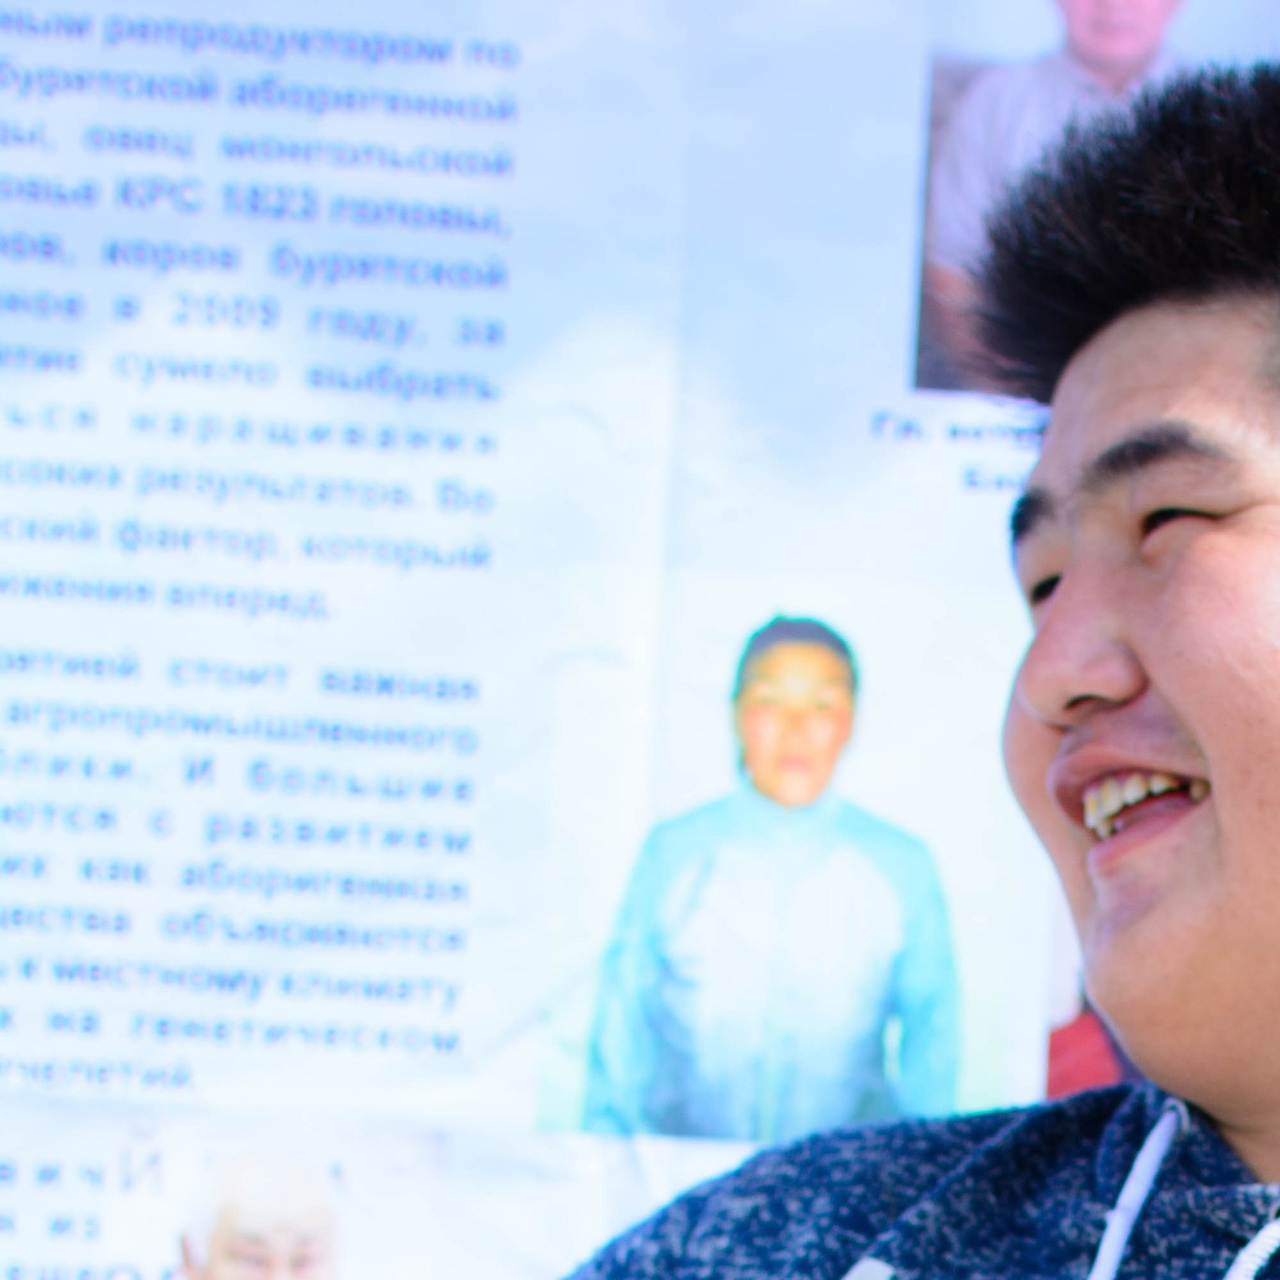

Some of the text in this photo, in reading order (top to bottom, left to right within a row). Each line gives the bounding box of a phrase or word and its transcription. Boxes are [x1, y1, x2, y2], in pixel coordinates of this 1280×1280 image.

[103, 16, 452, 63] репродуктором
[465, 39, 520, 67] по
[81, 124, 192, 157] овец
[219, 135, 514, 175] монгольской
[114, 175, 203, 213] КРС
[100, 236, 239, 272] коров
[270, 242, 507, 287] бурятской
[113, 294, 138, 319] в
[174, 291, 278, 328] 2009
[455, 316, 504, 346] за
[113, 354, 276, 385] сумело
[305, 362, 498, 400] выбрать
[131, 413, 496, 451] наращивания
[302, 537, 492, 569] который
[166, 659, 288, 686] стоит
[318, 668, 478, 702] важная
[7, 701, 478, 752] агропромышленного
[182, 754, 214, 785] И
[246, 758, 474, 801] большие
[148, 809, 168, 834] с
[204, 815, 471, 853] развитием
[78, 857, 149, 883] как
[178, 858, 467, 901] аборигенная
[160, 907, 465, 950] объясняются
[50, 957, 268, 1000] местному
[279, 973, 458, 1009] климату
[45, 1008, 100, 1035] на
[130, 1013, 461, 1056] генетическом
